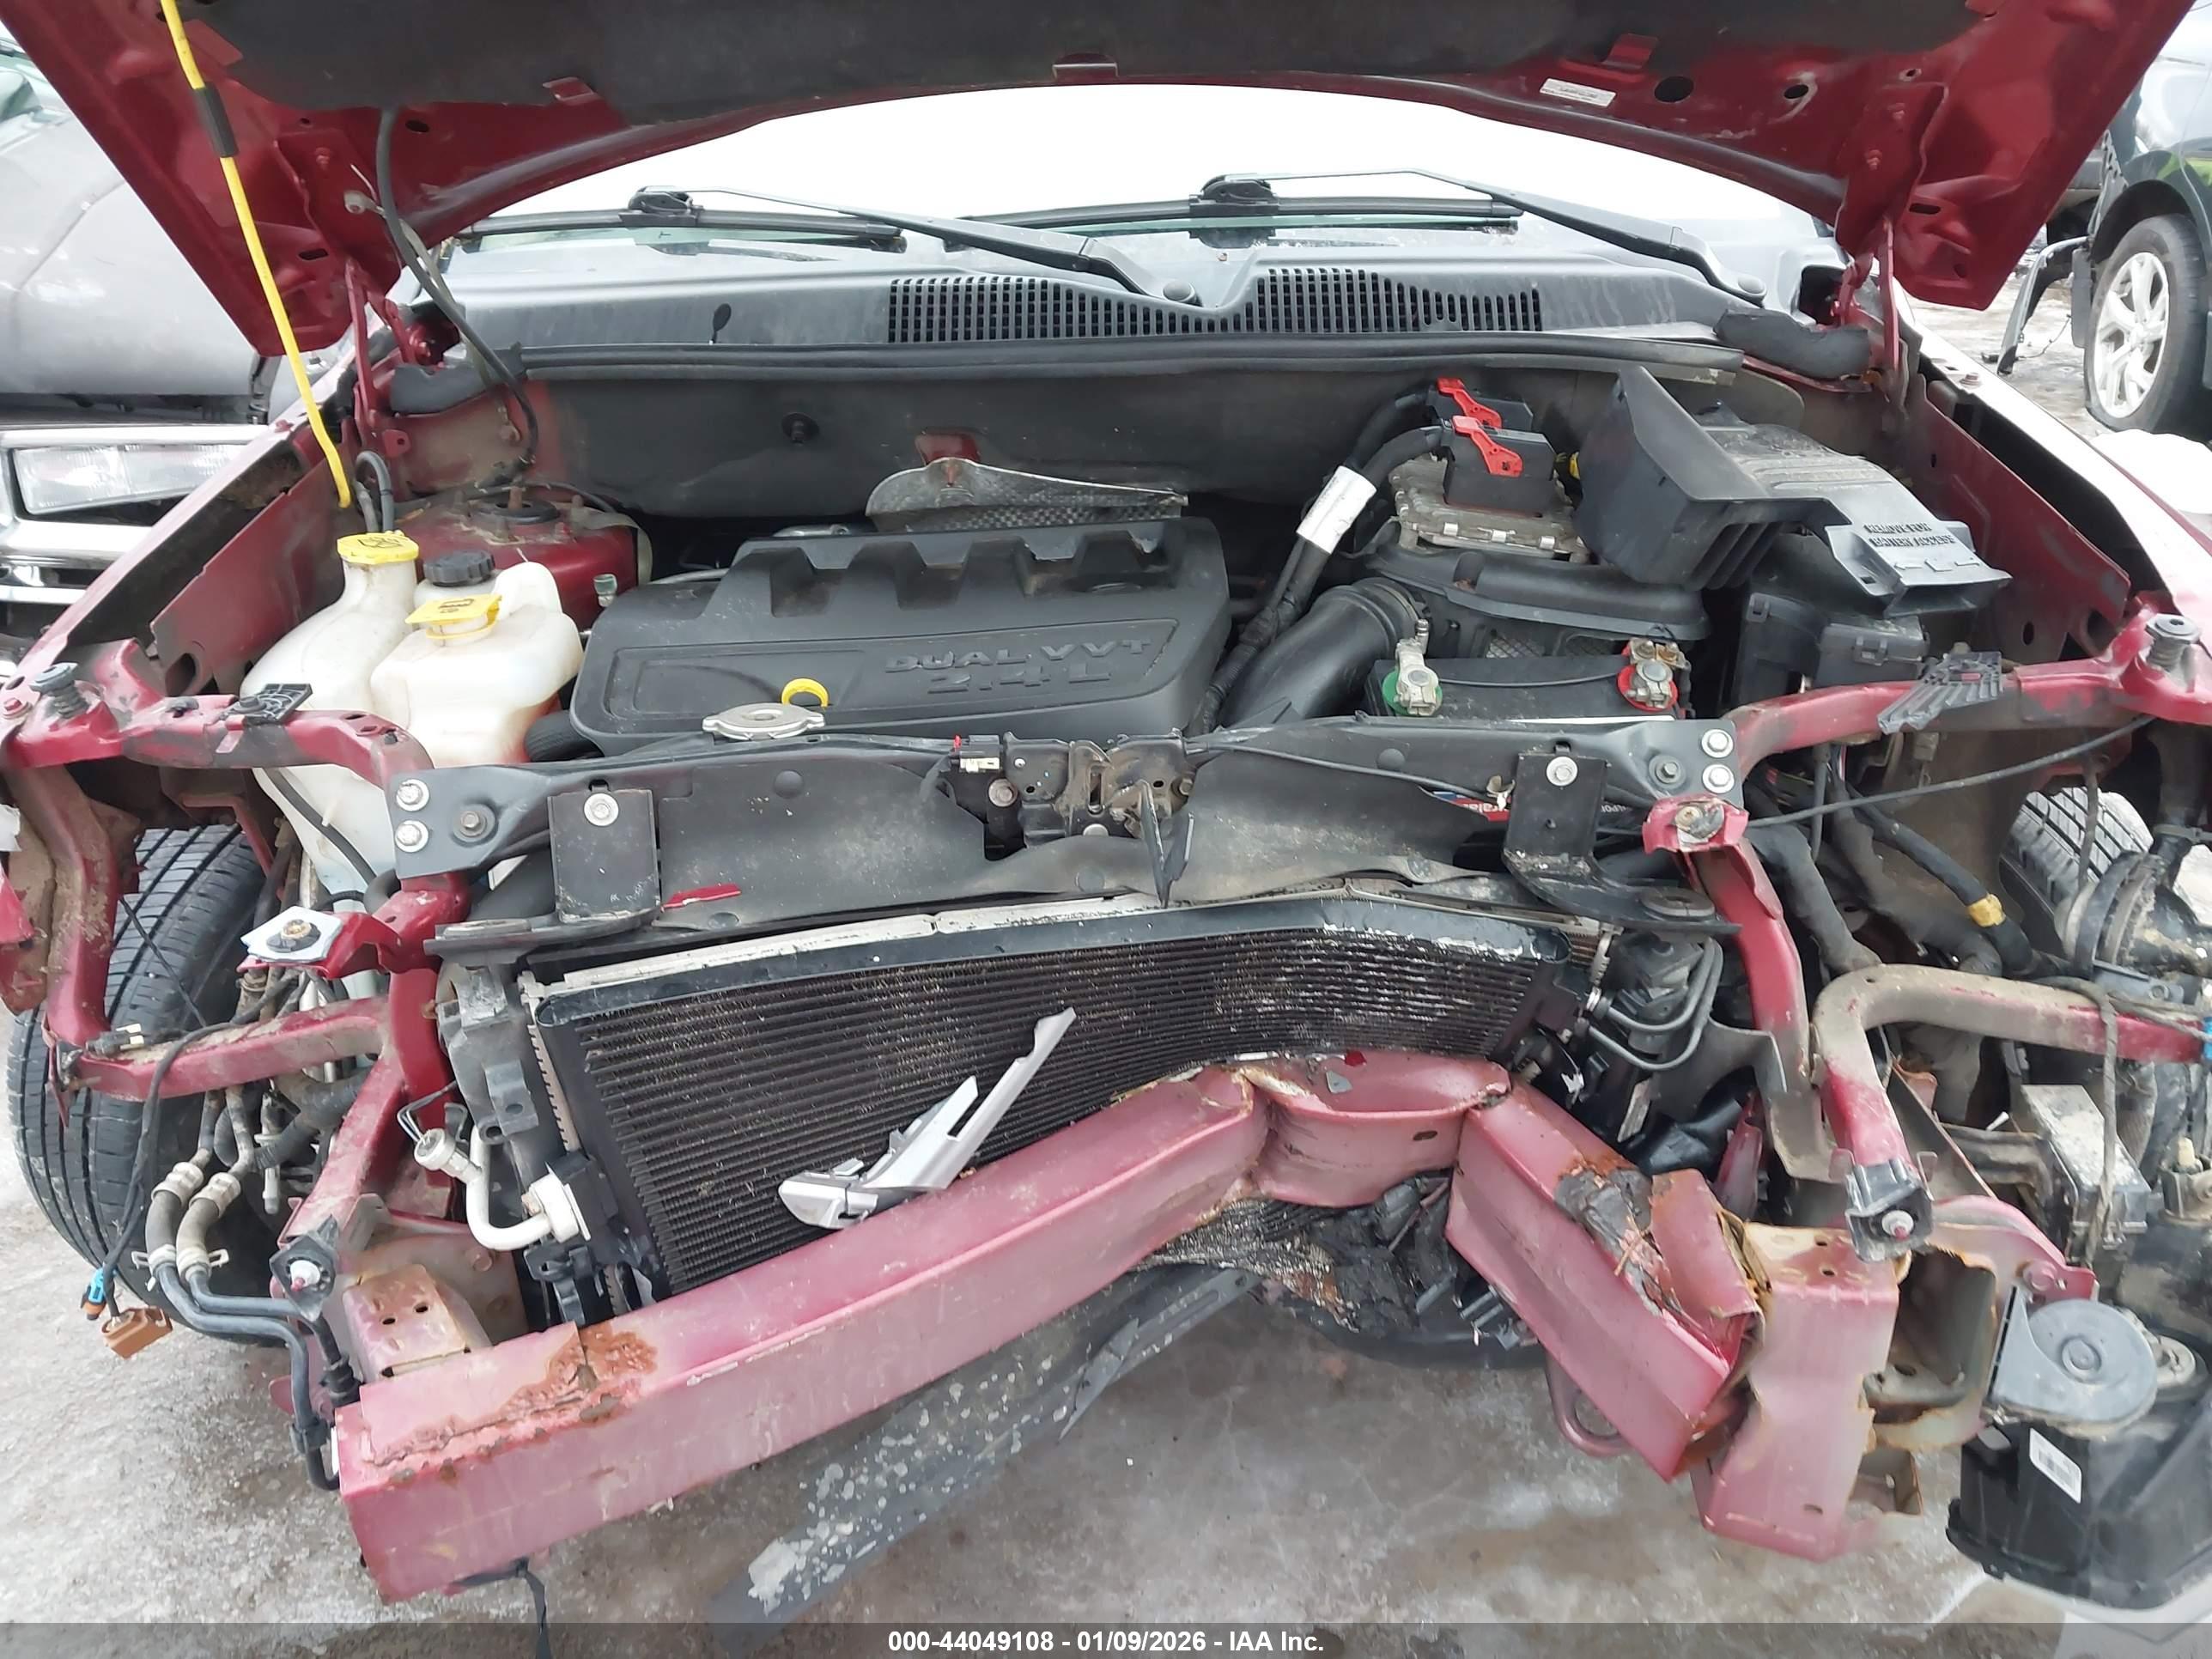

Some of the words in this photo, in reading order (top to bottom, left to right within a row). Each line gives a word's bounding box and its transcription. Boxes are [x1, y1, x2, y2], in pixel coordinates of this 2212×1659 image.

[885, 647, 1029, 674] DUAL
[1040, 639, 1152, 661] VVT
[927, 663, 1113, 694] 2.4L
